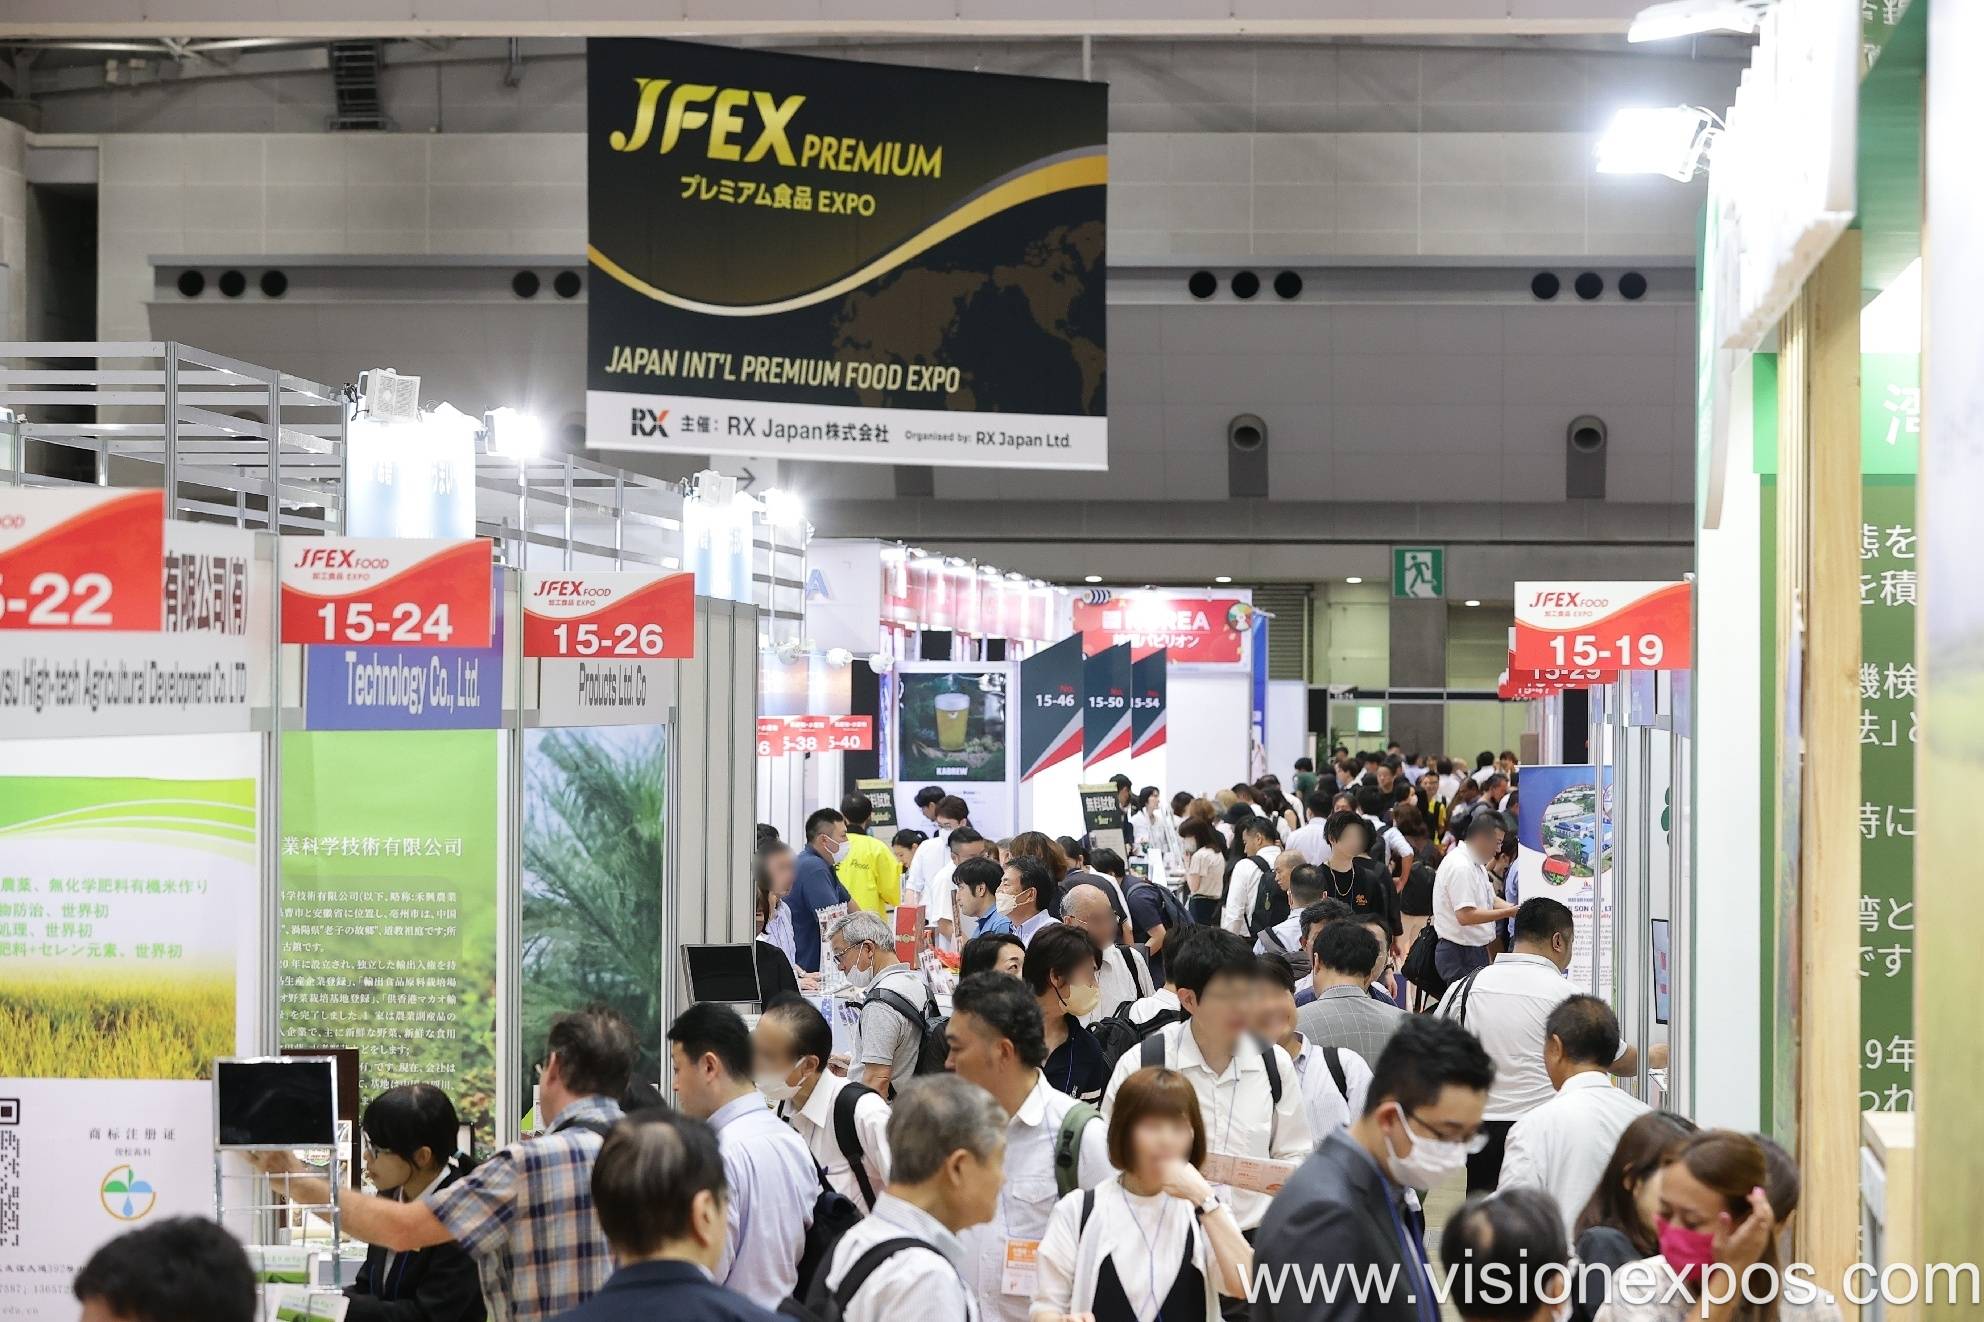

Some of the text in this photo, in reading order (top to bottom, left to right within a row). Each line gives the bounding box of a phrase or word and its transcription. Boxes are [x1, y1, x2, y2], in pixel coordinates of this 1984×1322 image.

[609, 78, 943, 178] JFEX PREMIUM
[680, 174, 876, 217] プレミアム食品 EXPO
[605, 346, 961, 394] JAPAN INT'L PREMIUM FOOD EXPO
[631, 408, 669, 437] RX
[728, 416, 756, 436] RX
[905, 430, 954, 442] Organised
[957, 432, 971, 443] by:
[976, 432, 995, 446] RX
[1000, 433, 1043, 449] Japan
[0, 515, 26, 529] OD
[294, 548, 389, 569] JFEX FOOD
[0, 571, 114, 626] -22
[533, 580, 611, 597] JFEX FOOD
[1529, 592, 1609, 608] JFEX FOOD
[318, 602, 453, 642] 15-24
[1125, 611, 1210, 631] KREA
[553, 623, 664, 655] 15-26
[1549, 634, 1664, 667] 15-19
[23, 658, 80, 713] High-tech
[82, 658, 147, 713] Agricultural
[149, 660, 211, 712] Development
[345, 650, 481, 715] Technology Co., Ltd.
[578, 662, 647, 707] Products Ltd. Co
[1035, 694, 1075, 707] 15-46
[1088, 696, 1125, 708] 15-50
